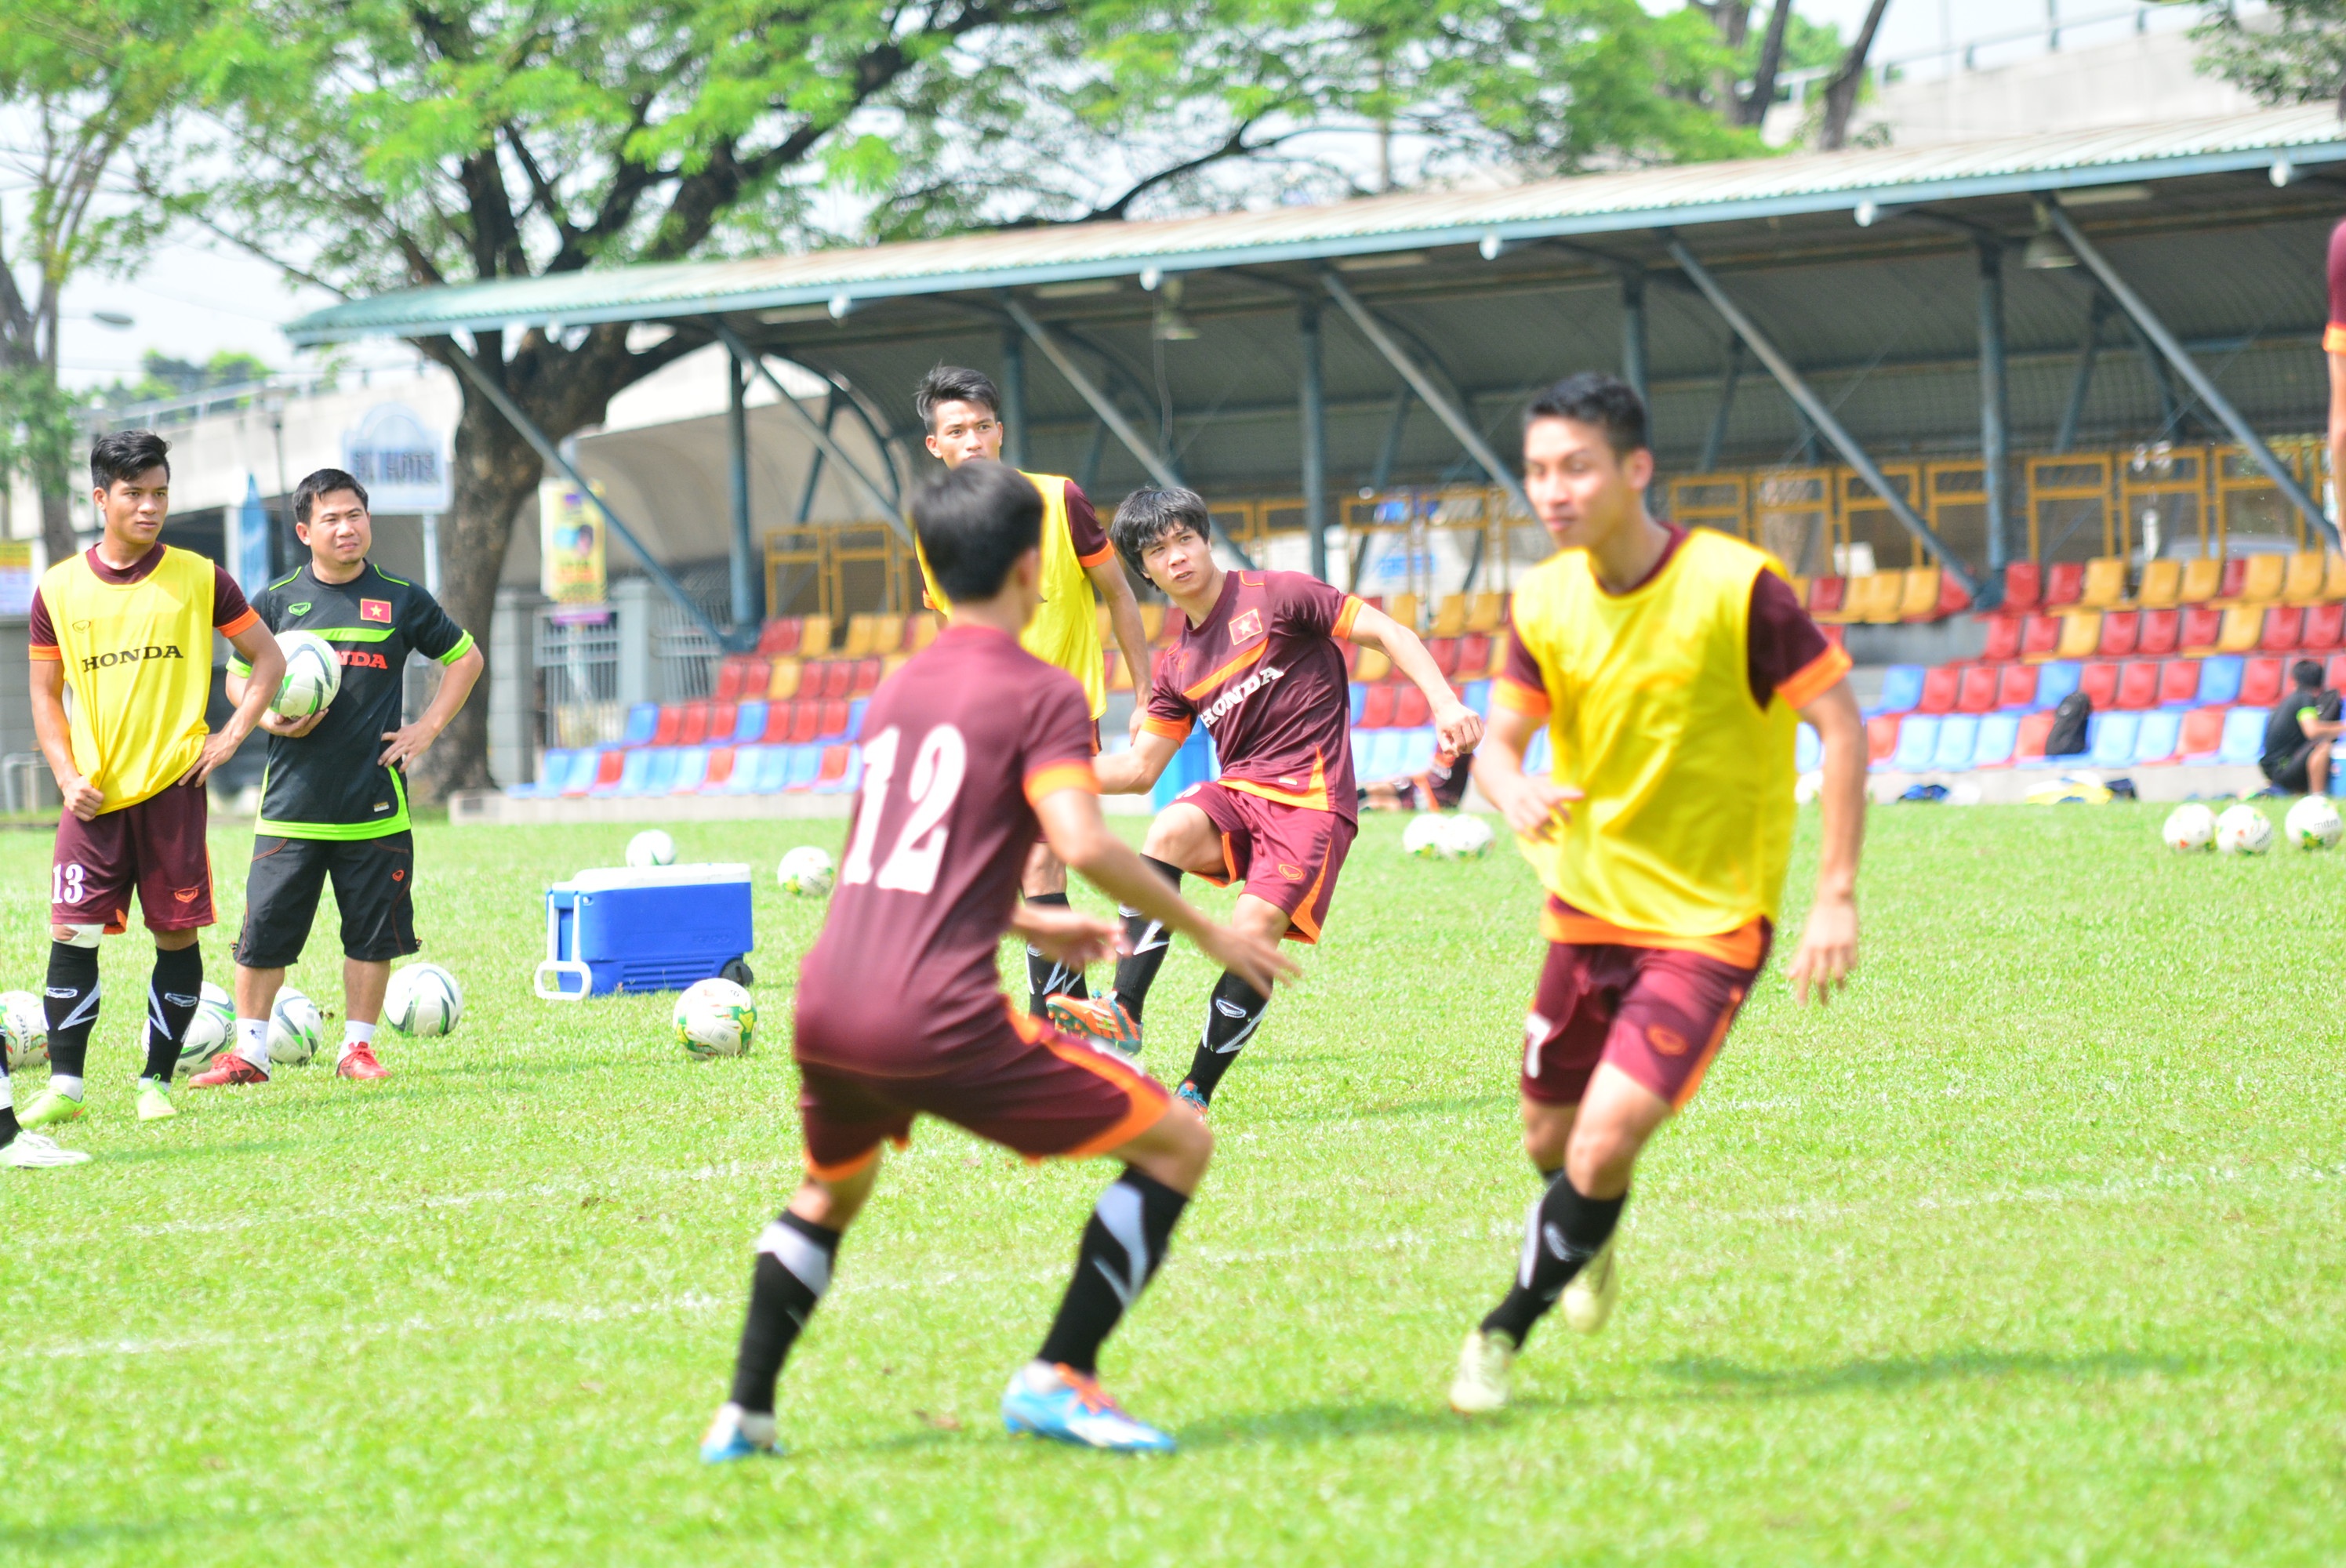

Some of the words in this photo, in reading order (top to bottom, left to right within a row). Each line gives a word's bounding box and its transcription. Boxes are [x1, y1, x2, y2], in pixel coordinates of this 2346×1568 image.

[82, 645, 184, 673] HONDA
[335, 651, 388, 670] NDA
[1200, 666, 1284, 729] HONDA
[843, 722, 968, 896] 12
[52, 863, 84, 904] 13
[16, 1014, 29, 1054] mitre
